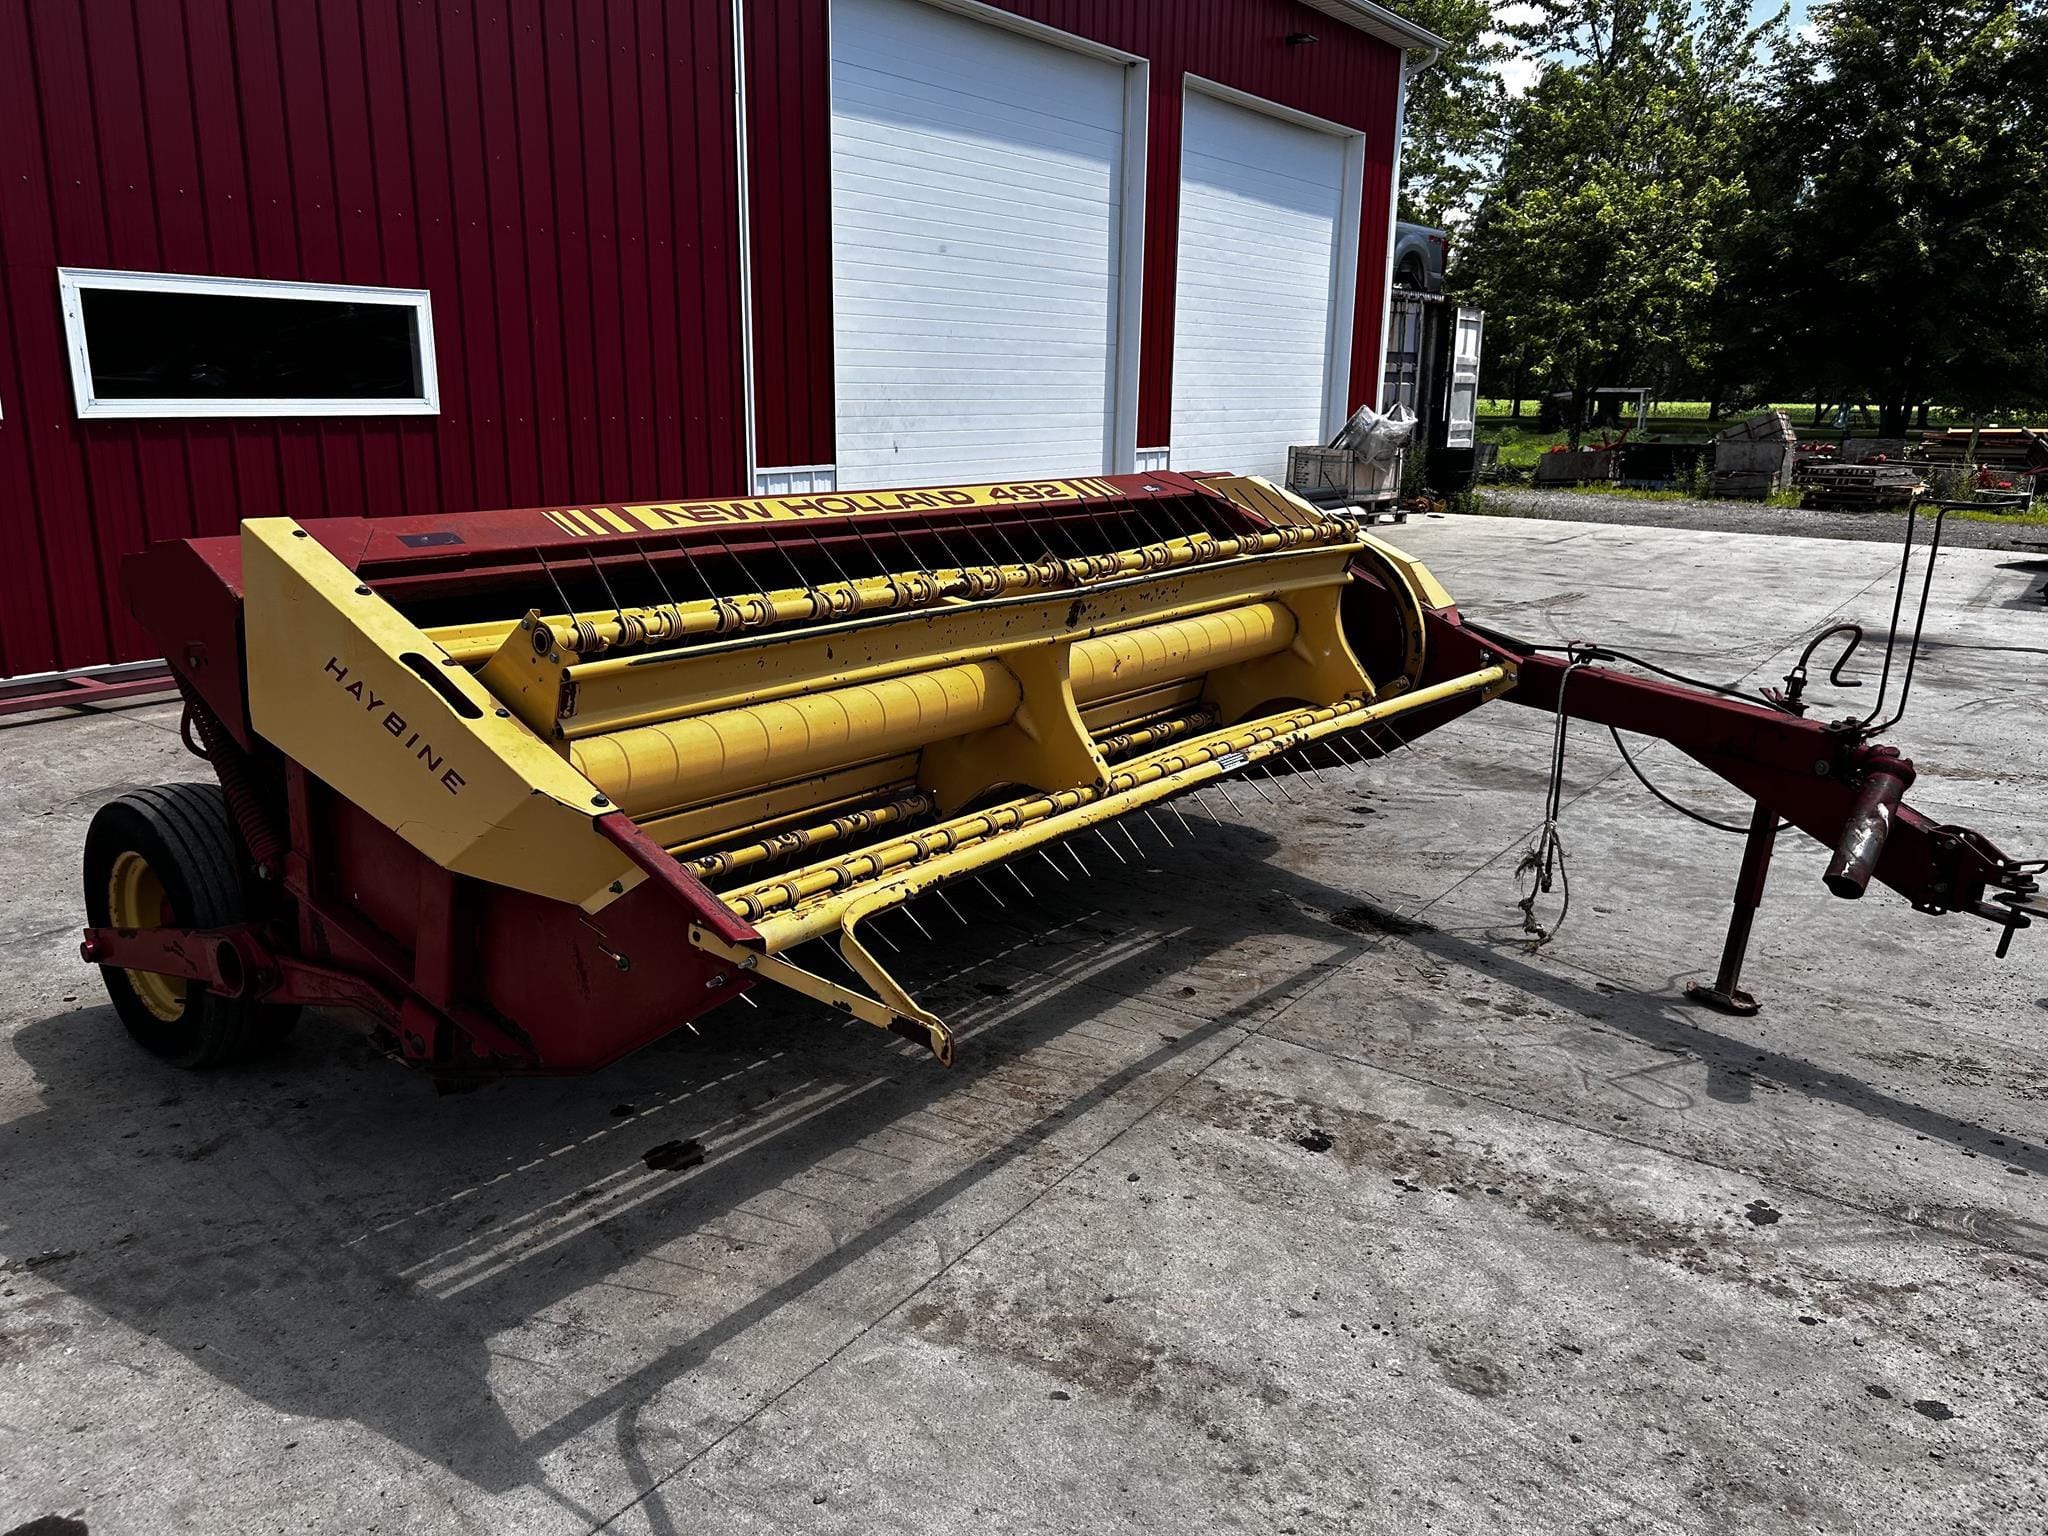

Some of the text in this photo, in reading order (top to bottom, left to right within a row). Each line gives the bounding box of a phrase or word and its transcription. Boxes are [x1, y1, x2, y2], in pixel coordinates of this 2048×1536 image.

[650, 483, 1070, 525] NEW HOLLAND 492
[323, 656, 467, 796] HAYBINE
